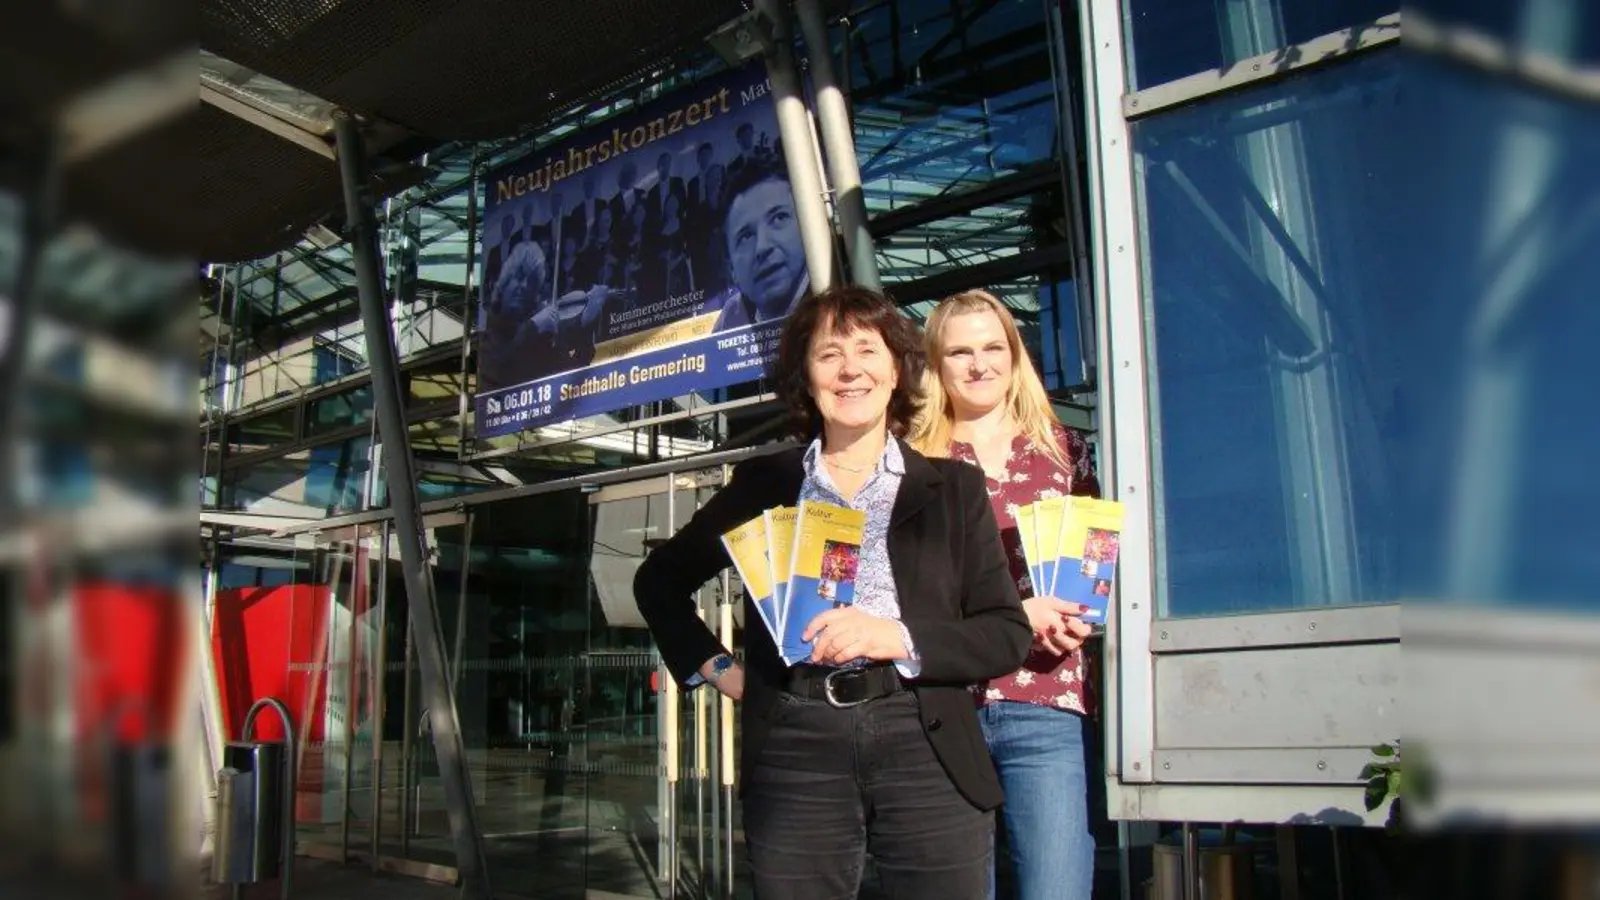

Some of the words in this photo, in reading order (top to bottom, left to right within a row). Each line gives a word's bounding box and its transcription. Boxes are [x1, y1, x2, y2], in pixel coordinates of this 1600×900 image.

[496, 87, 730, 204] Neujahrskonzert
[610, 290, 704, 324] Kammerorchester
[504, 384, 552, 410] 06.01.18
[560, 371, 626, 401] Stadthalle
[630, 353, 705, 385] Germering
[805, 506, 832, 519] Kultur
